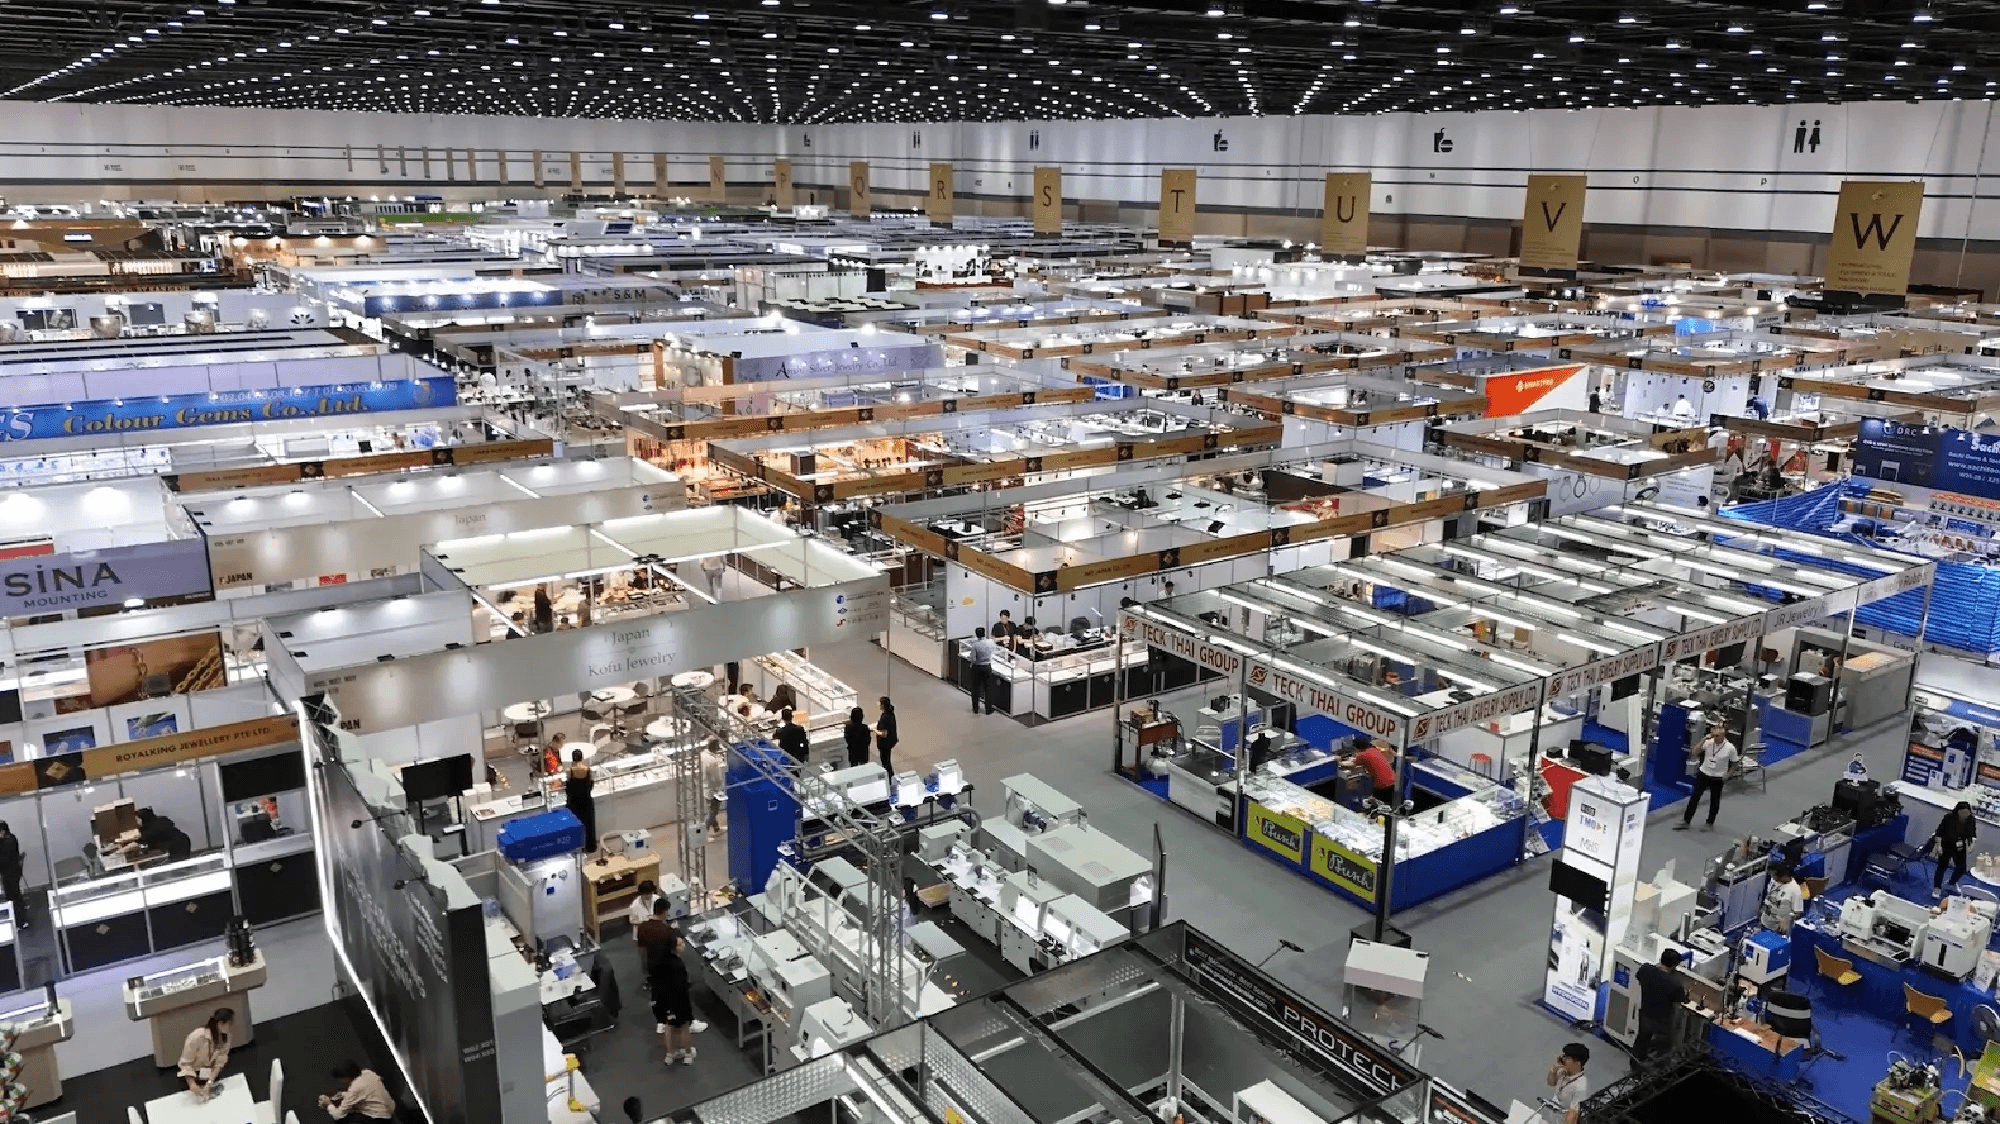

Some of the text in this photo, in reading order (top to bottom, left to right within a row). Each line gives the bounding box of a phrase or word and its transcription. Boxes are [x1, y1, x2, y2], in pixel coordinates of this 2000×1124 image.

[855, 176, 865, 199] Q
[937, 180, 946, 200] R
[1042, 185, 1052, 207] S
[1170, 189, 1185, 213] T
[1337, 195, 1356, 223] U
[1541, 201, 1567, 233] V
[1850, 212, 1904, 252] W
[63, 412, 166, 434] Colour
[176, 408, 252, 424] Gems
[24, 590, 108, 609] MOUNTING
[612, 627, 649, 645] Japan
[1142, 622, 1239, 674] TECK THAI GROUP
[588, 651, 677, 677] Kofu Jewelry
[1273, 672, 1396, 738] TECK THAI GROUP
[1434, 710, 1451, 733] TECK
[1453, 704, 1469, 729] THAI
[116, 744, 177, 762] ROYALKING
[180, 734, 230, 752] JEWELLERY
